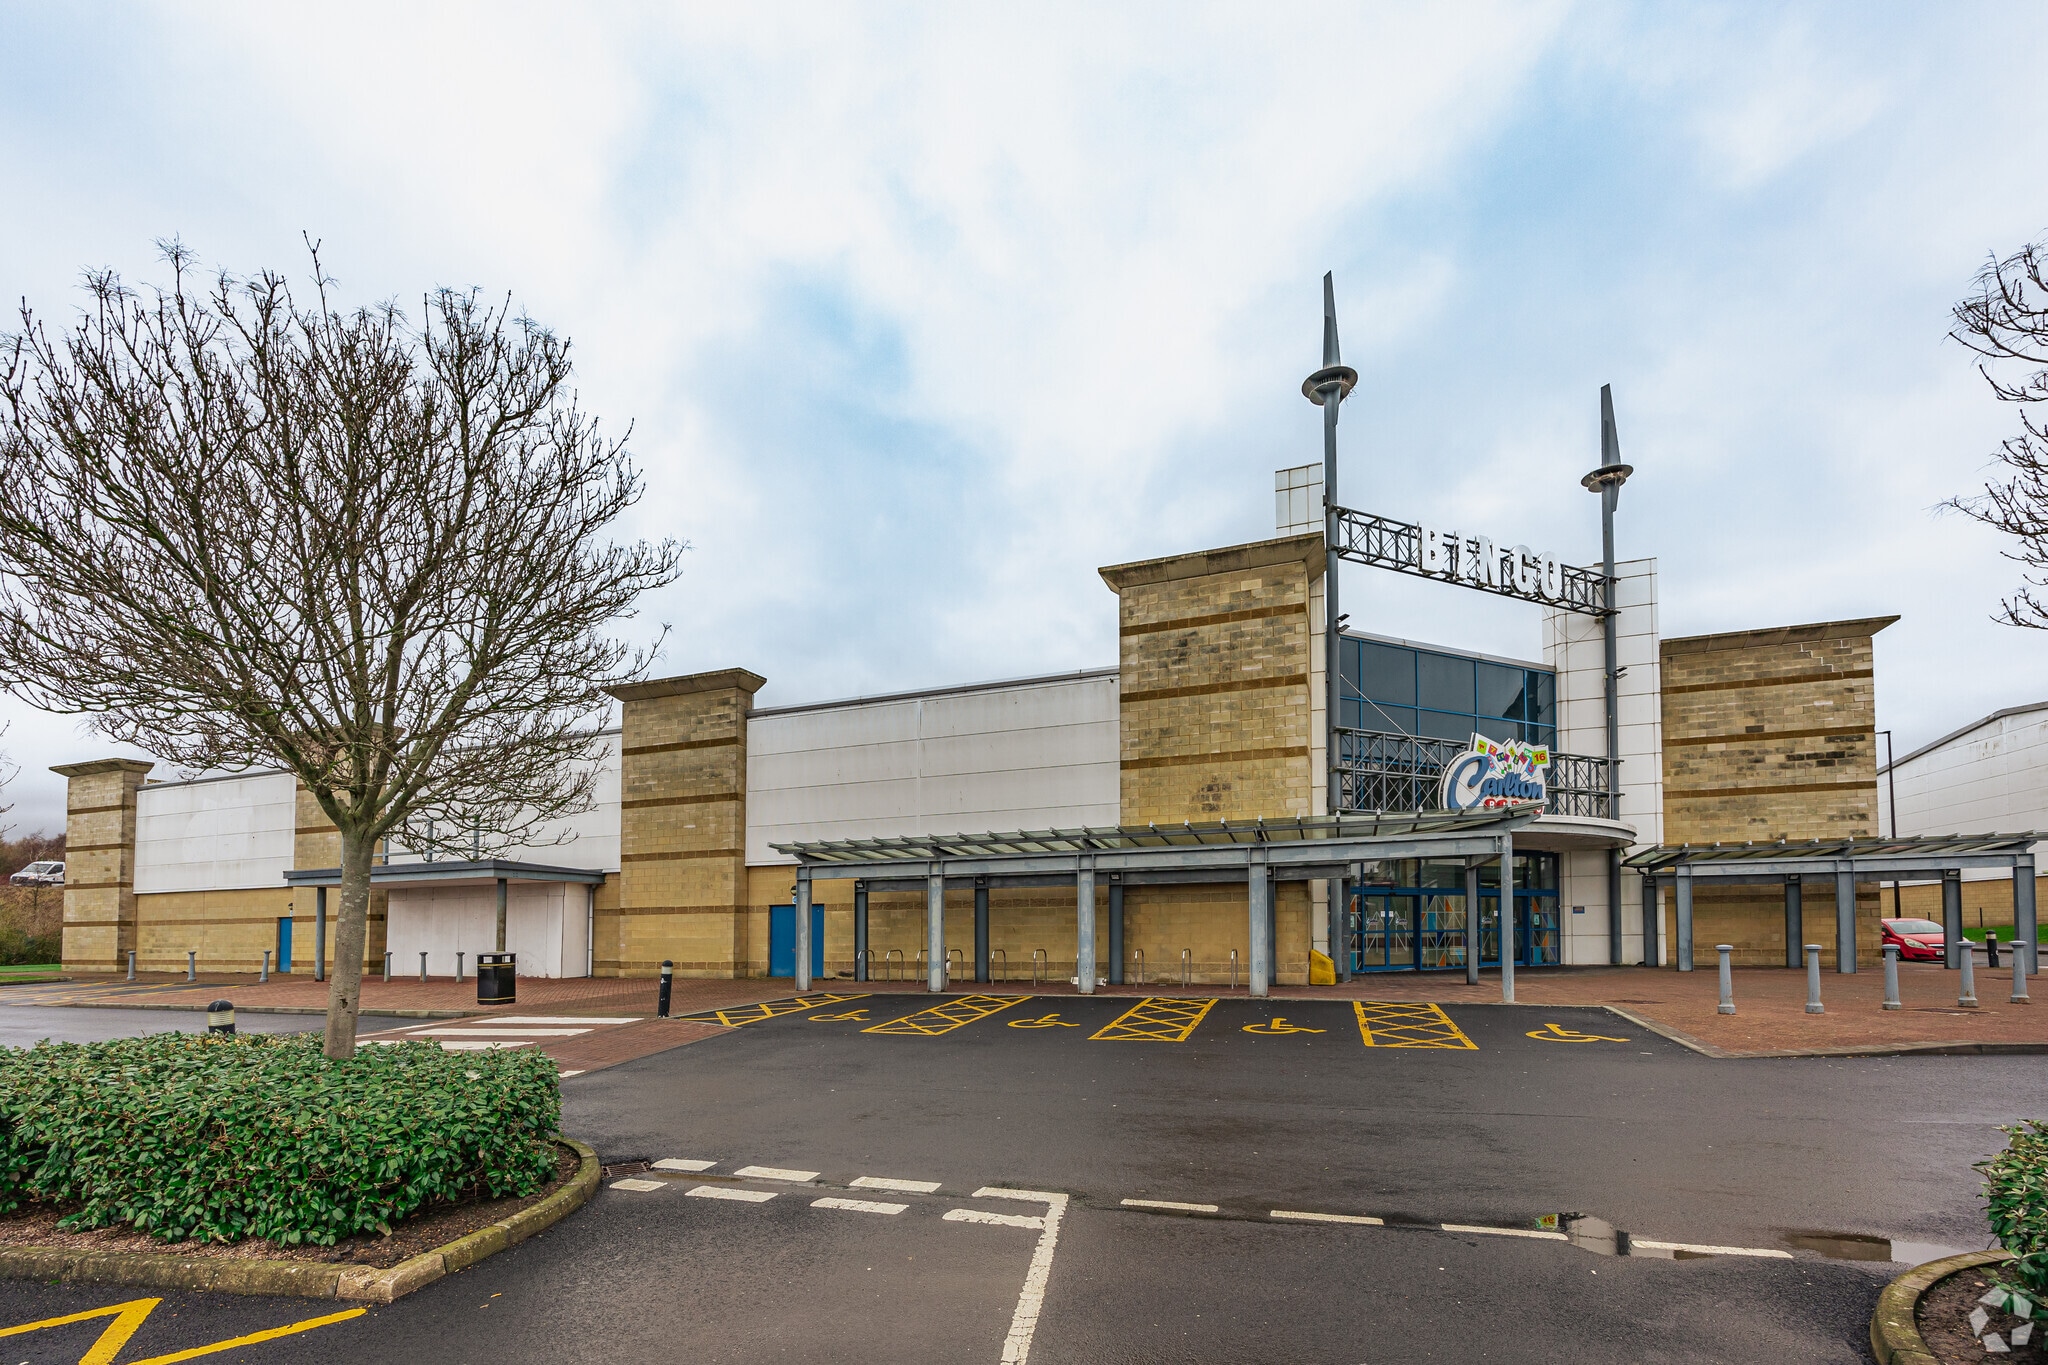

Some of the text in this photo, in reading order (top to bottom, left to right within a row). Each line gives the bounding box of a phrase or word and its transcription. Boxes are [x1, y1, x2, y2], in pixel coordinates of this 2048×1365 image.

[1417, 521, 1562, 601] BINGO
[1447, 755, 1543, 809] Carlton
[1534, 753, 1546, 762] 16
